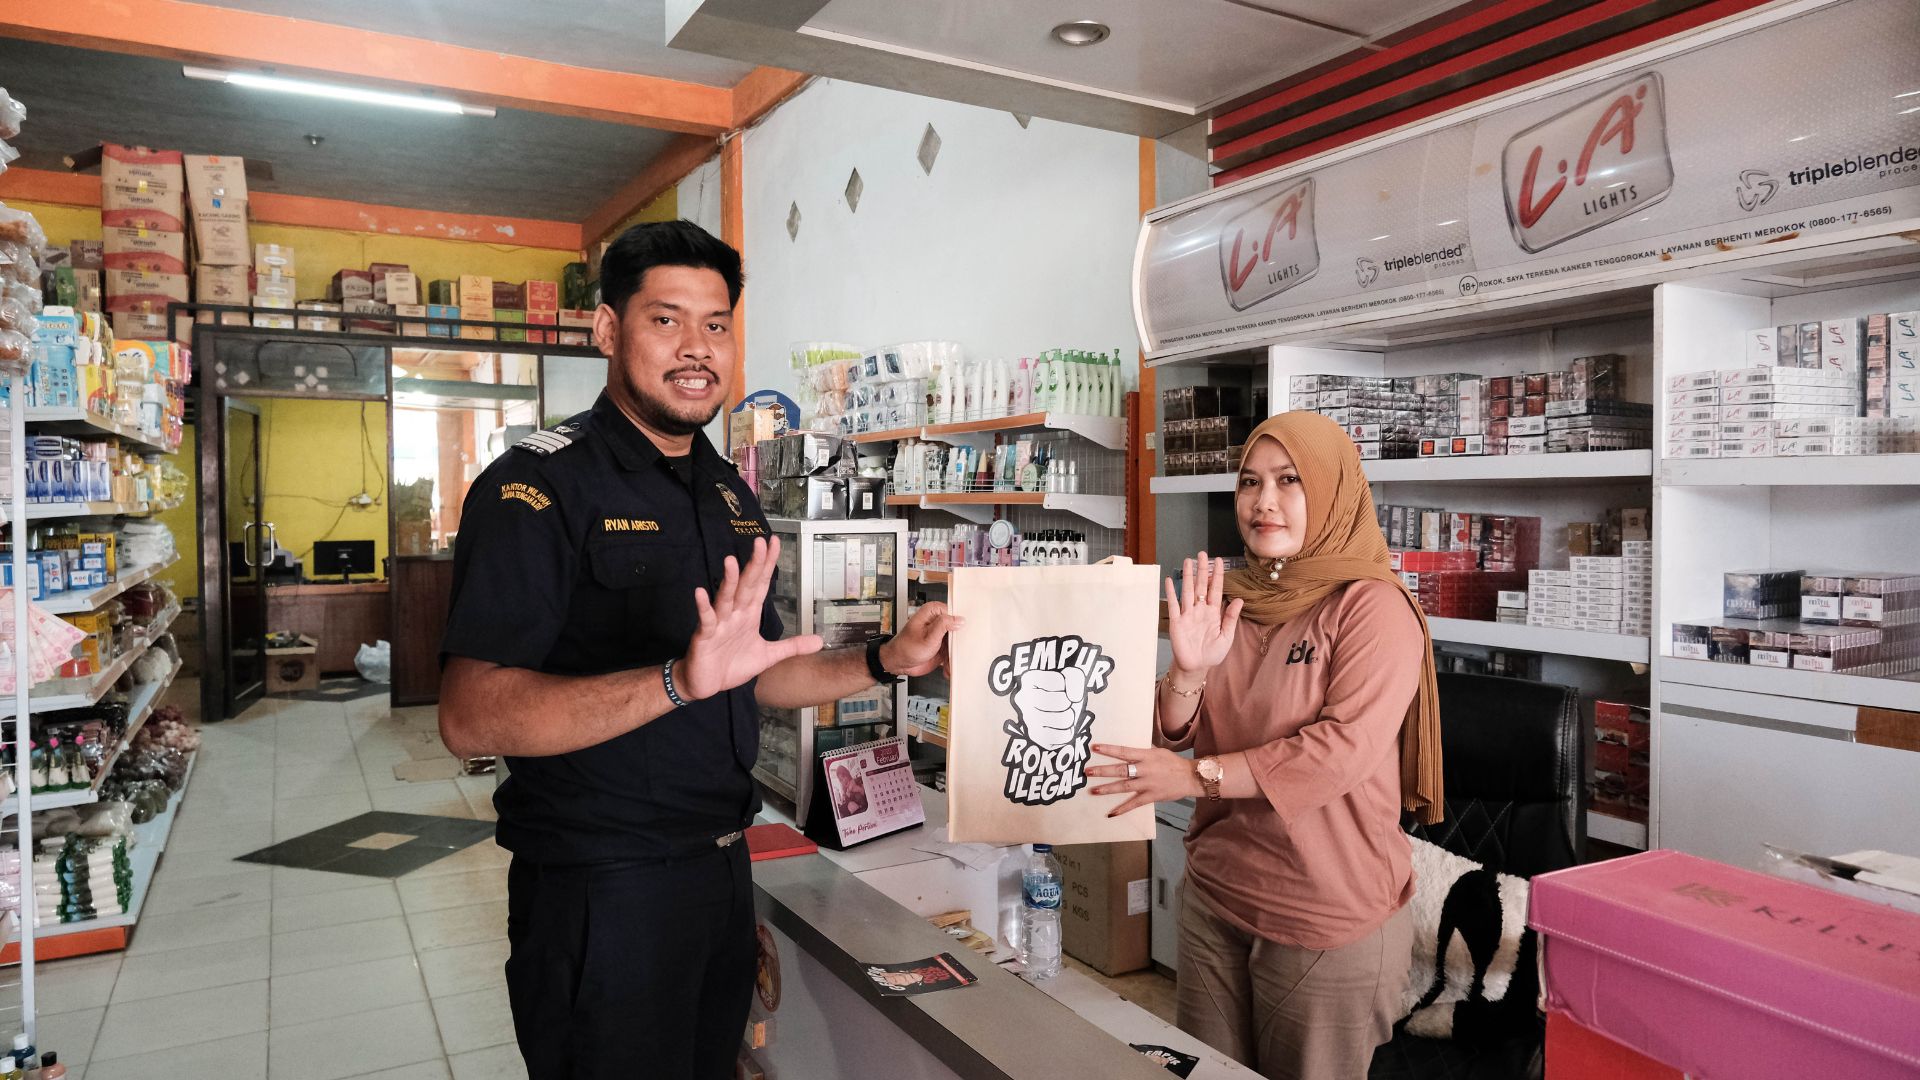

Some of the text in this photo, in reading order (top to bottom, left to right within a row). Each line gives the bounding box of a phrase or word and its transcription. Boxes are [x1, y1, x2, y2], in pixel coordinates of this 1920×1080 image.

[1788, 146, 1920, 186] tripleblende
[1878, 163, 1920, 179] proce
[1583, 185, 1638, 216] LIGHTS
[1461, 281, 1477, 293] 18+
[1506, 273, 1524, 284] SAYA
[1525, 266, 1560, 280] TERKENA
[1561, 261, 1592, 274] KANKER
[1594, 249, 1659, 268] TENGGOROKAN.
[1661, 240, 1702, 255] LAYANAN
[1704, 231, 1752, 248] BERHENTI
[1754, 221, 1806, 239] MEROKOK
[1809, 205, 1892, 229] (0800-177-6565)
[1267, 263, 1301, 285] LIGHTS
[1258, 319, 1277, 328] KANKER
[1316, 307, 1341, 318] LAYANAN
[1341, 303, 1368, 314] BERHENTI
[1368, 297, 1397, 308] MEROKOK
[501, 483, 552, 508] KANTOR WILAYAH
[501, 491, 515, 500] JAWA
[604, 519, 660, 531] RYAN ARISTO
[992, 638, 1112, 692] GEMPUR
[1005, 735, 1089, 775] ROKOK
[1008, 762, 1083, 801] ILEGAL
[1036, 886, 1060, 899] AQUA
[1072, 881, 1089, 899] PCS
[1072, 903, 1090, 923] KGS
